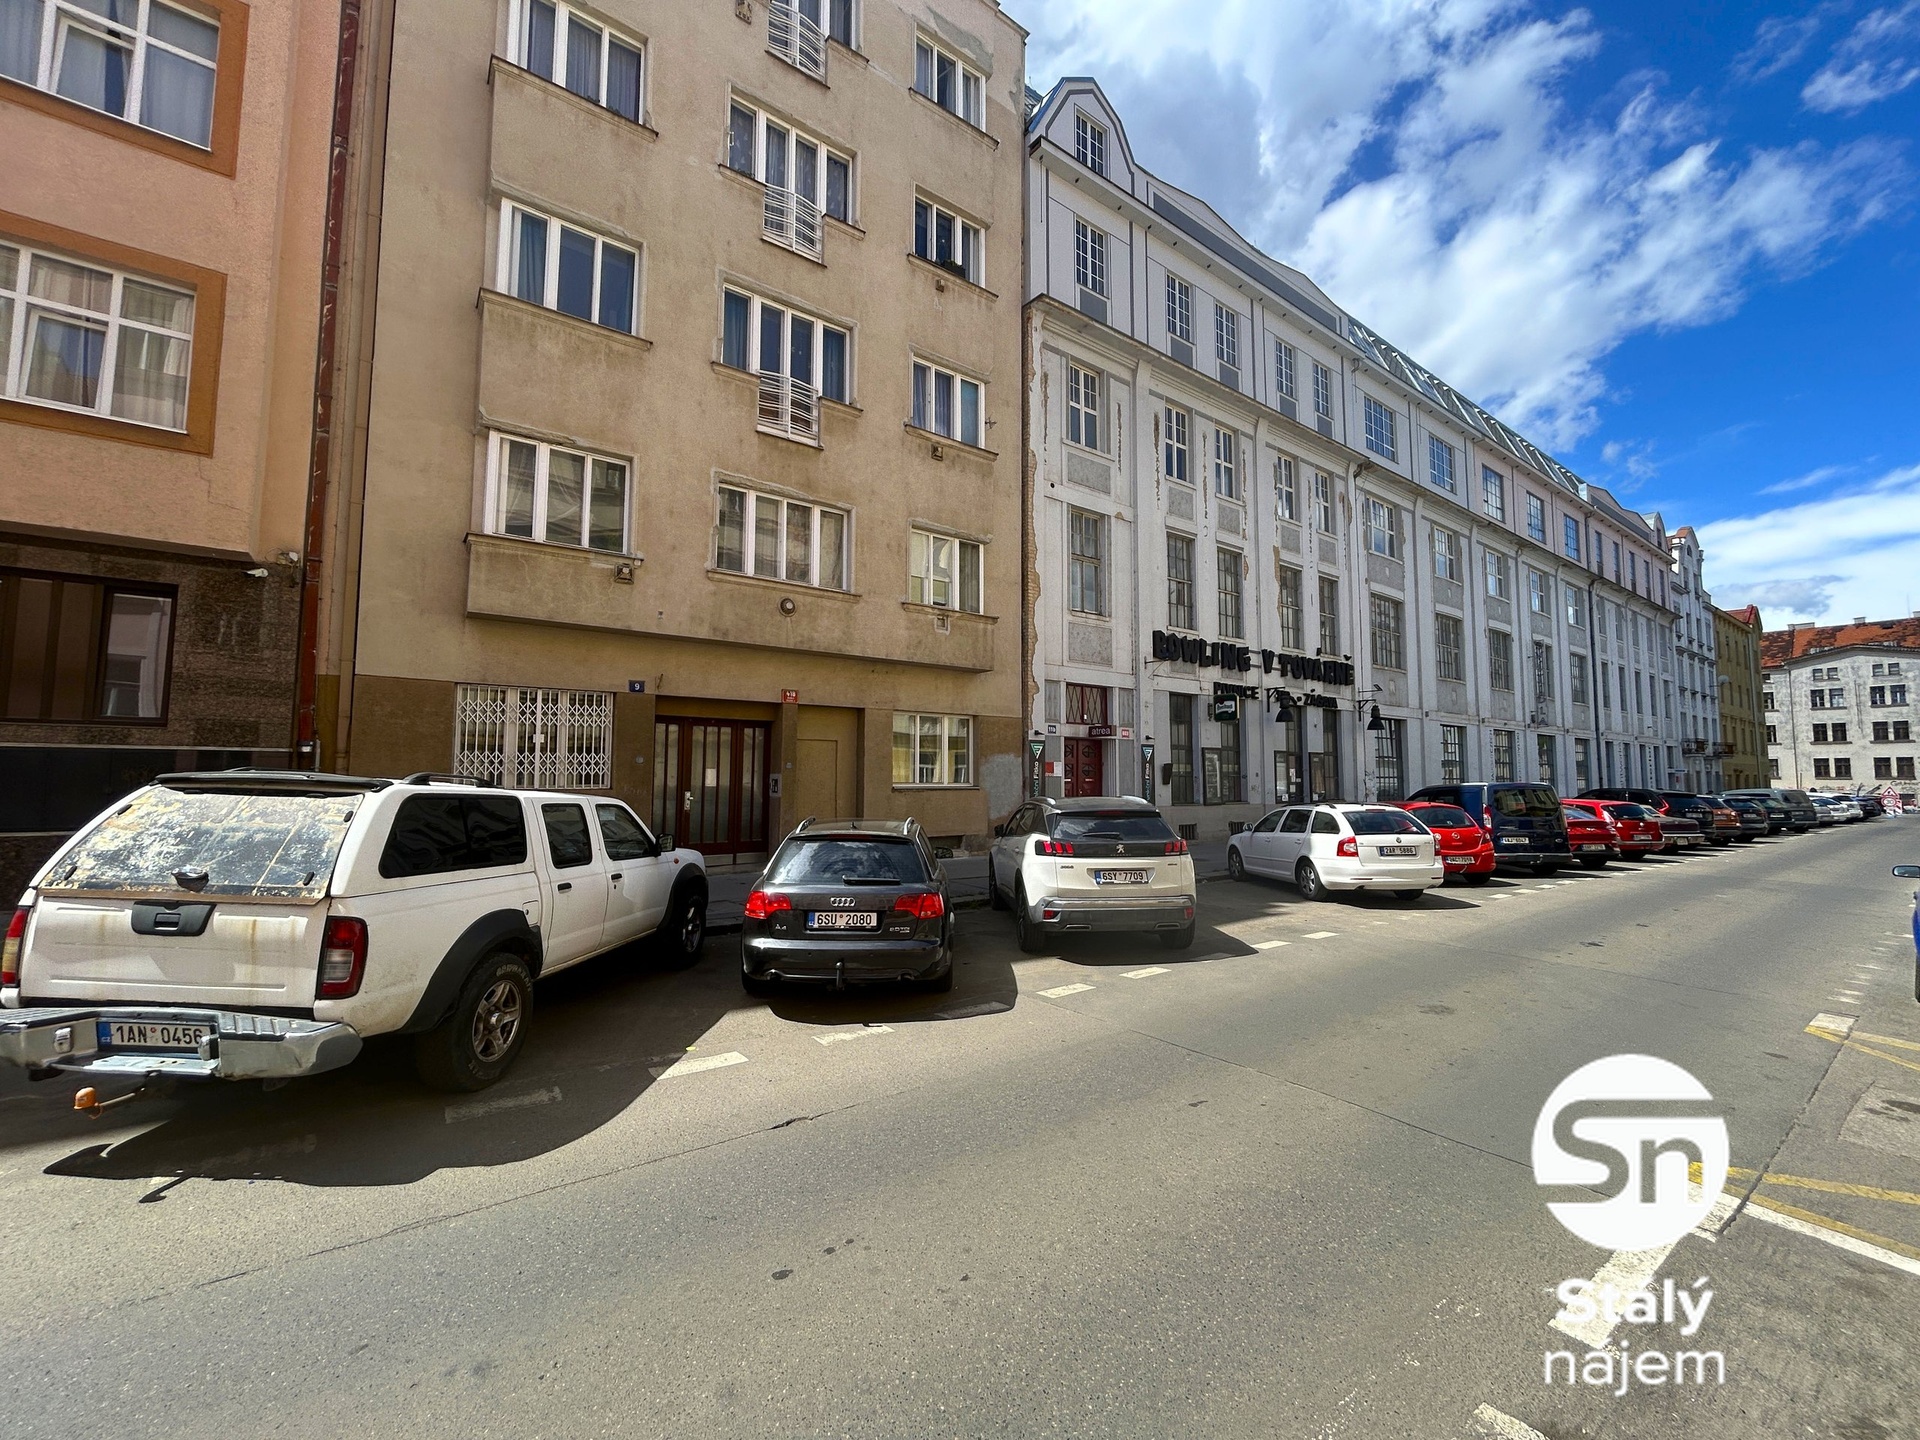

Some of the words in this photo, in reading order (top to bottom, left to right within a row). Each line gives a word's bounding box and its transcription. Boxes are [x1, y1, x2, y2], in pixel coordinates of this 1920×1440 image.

[1152, 629, 1251, 672] BOWLING
[1261, 649, 1275, 674] V
[1091, 727, 1111, 736] atrea
[1102, 872, 1117, 881] 6SY
[1123, 872, 1144, 881] 7709
[817, 913, 837, 925] 6SU
[845, 913, 872, 925] 2080
[116, 1025, 147, 1044] 1AN
[160, 1026, 203, 1045] 0456
